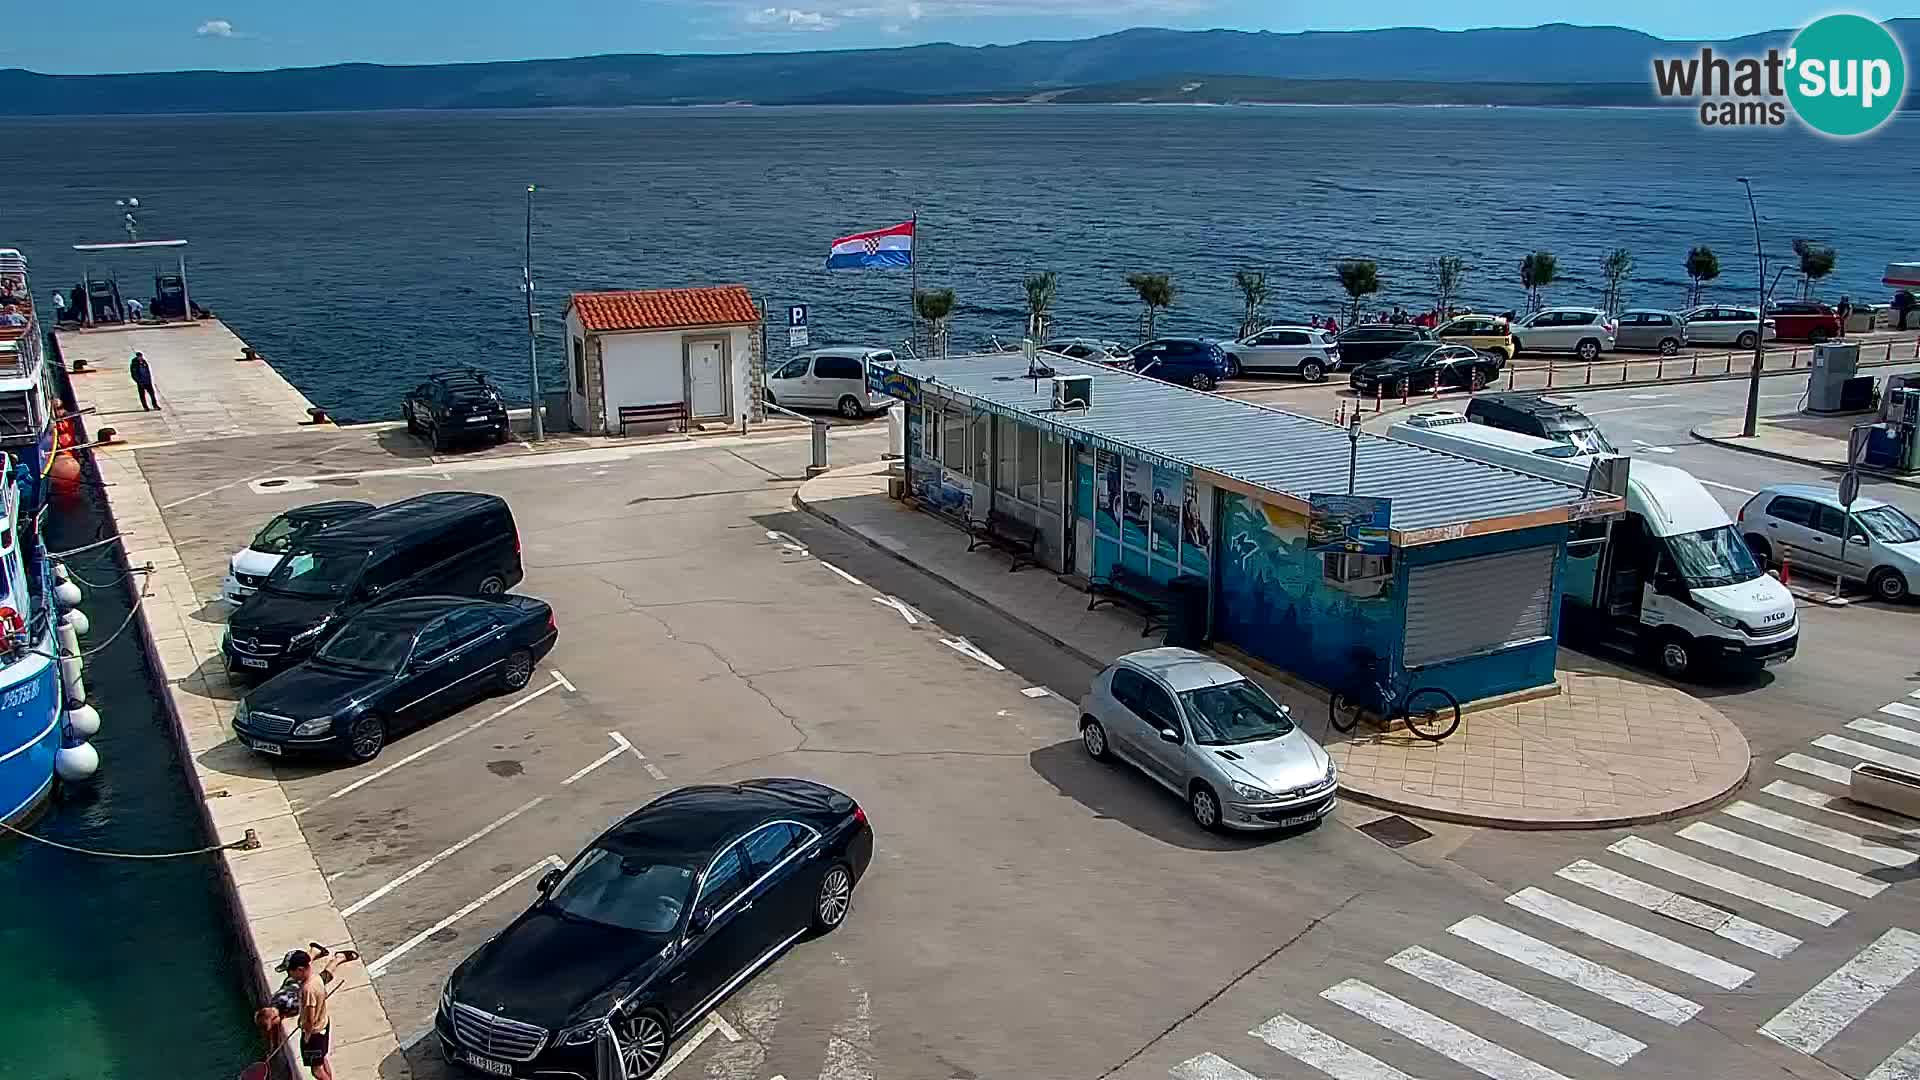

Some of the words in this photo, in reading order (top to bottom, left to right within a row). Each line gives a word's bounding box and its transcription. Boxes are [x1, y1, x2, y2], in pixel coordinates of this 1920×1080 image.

[792, 307, 802, 324] P
[1091, 437, 1105, 449] BUS
[1106, 440, 1136, 457] STATION
[1138, 451, 1162, 466] TICKET
[1163, 459, 1189, 475] OFFICE
[1763, 612, 1786, 624] IVECO
